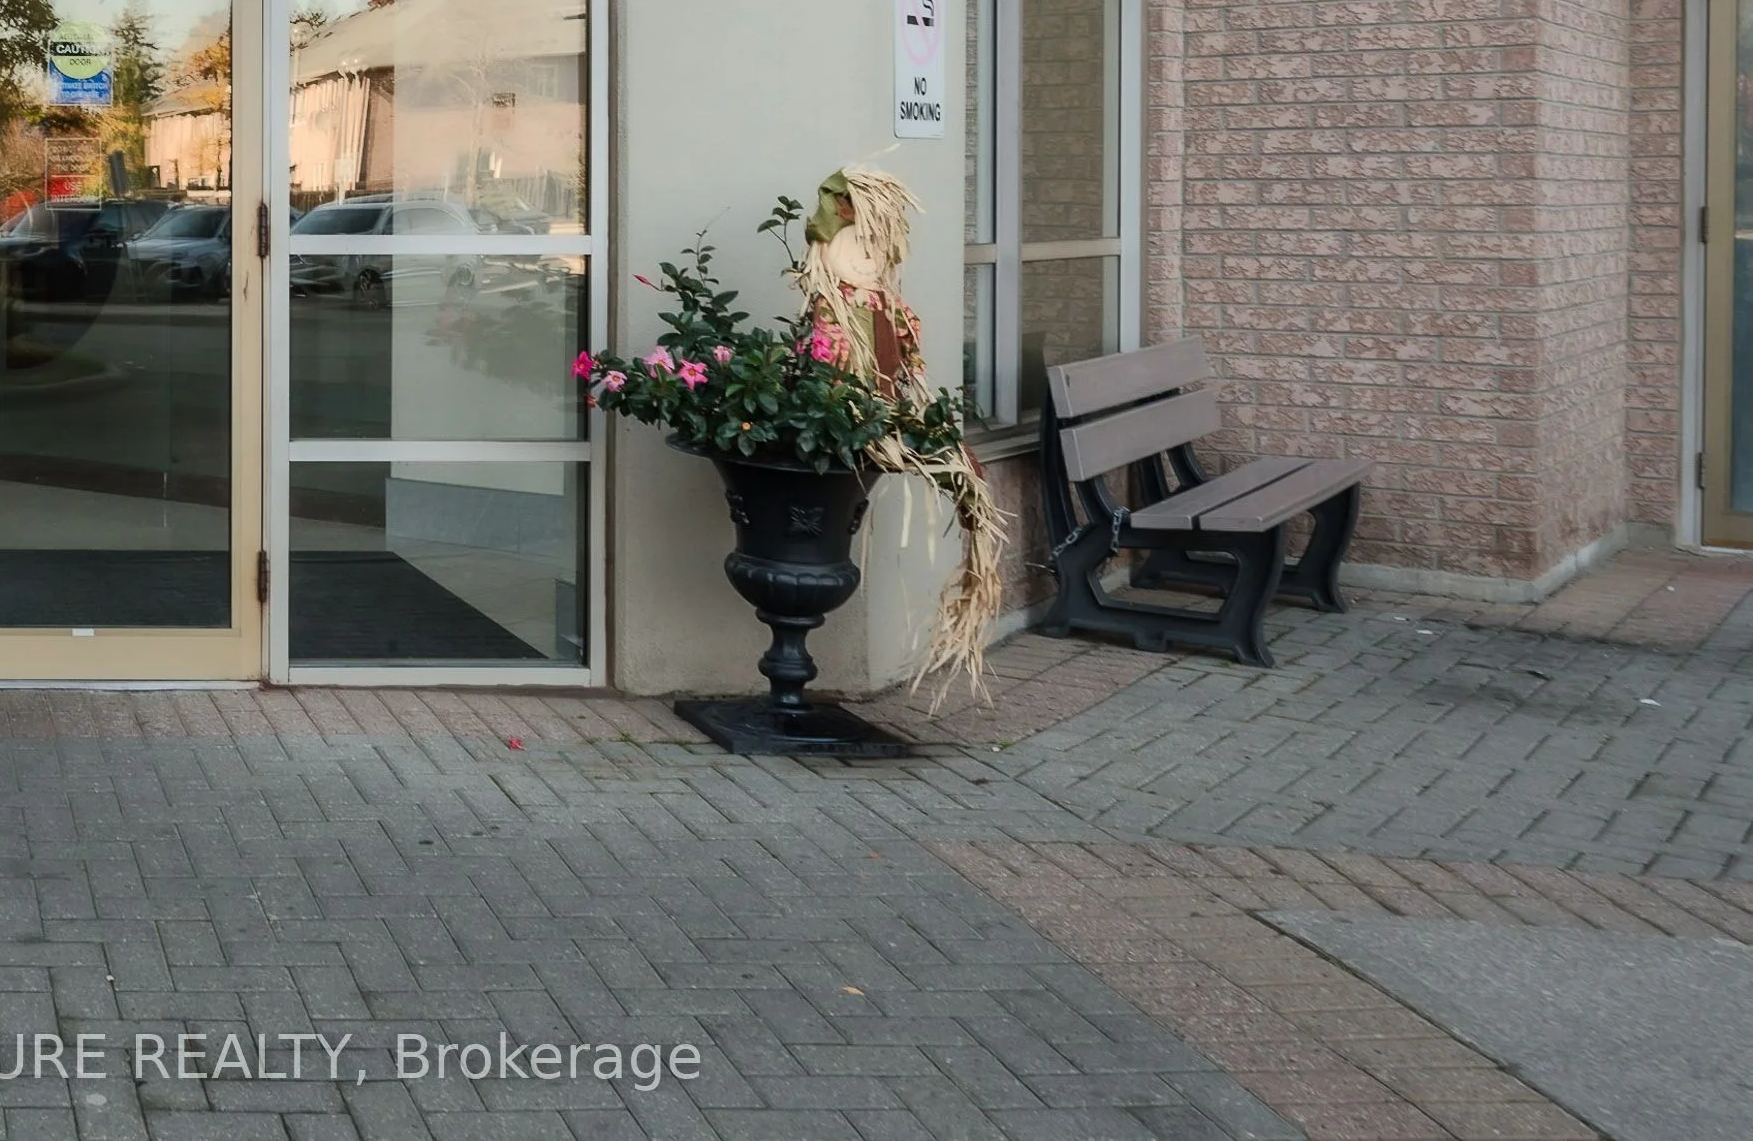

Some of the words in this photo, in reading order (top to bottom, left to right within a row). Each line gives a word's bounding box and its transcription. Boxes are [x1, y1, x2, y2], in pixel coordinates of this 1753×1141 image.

[69, 58, 92, 66] DOOR
[913, 76, 927, 96] NO
[900, 100, 941, 122] SMOKING
